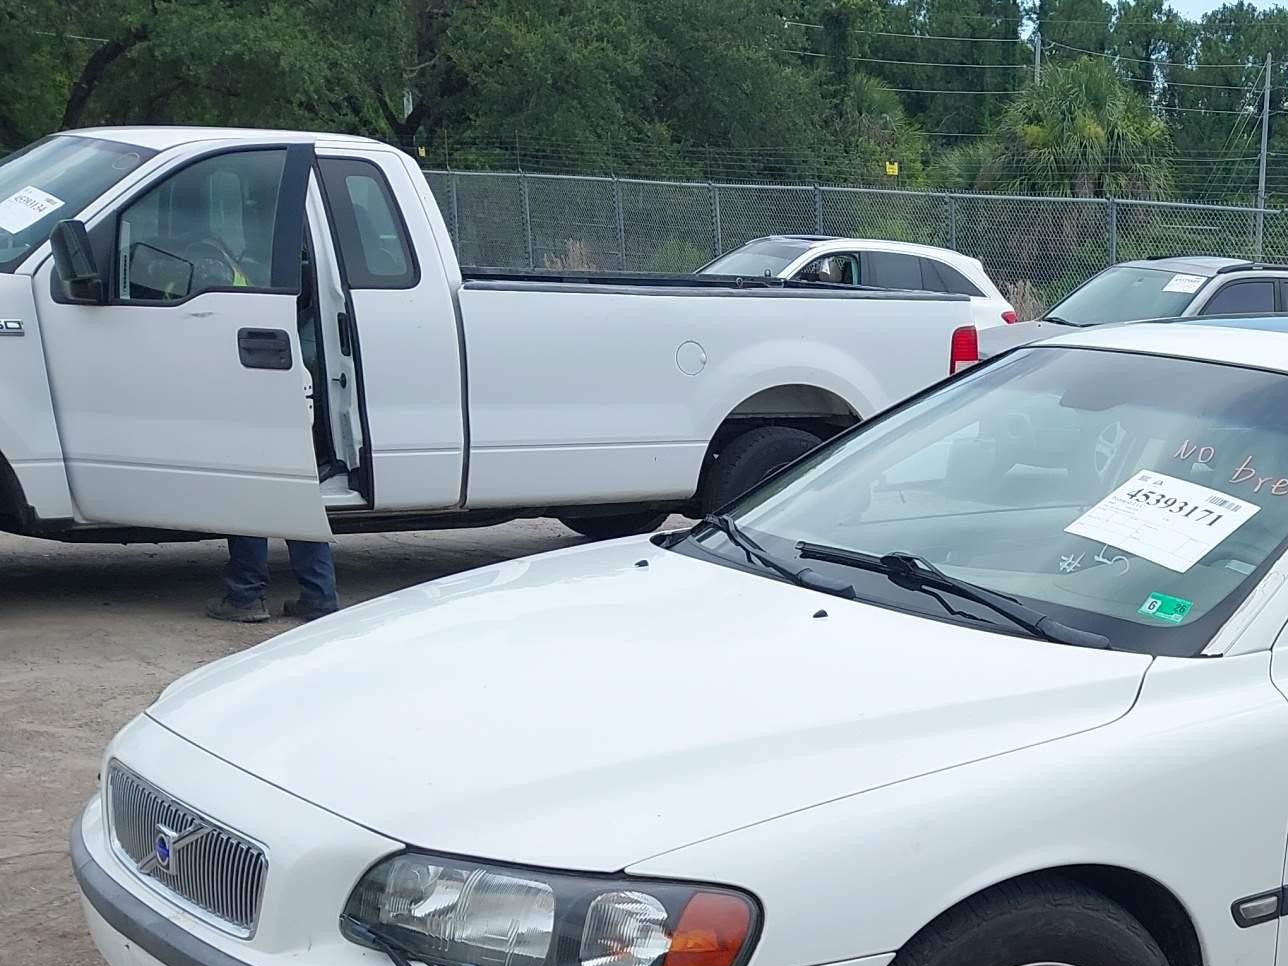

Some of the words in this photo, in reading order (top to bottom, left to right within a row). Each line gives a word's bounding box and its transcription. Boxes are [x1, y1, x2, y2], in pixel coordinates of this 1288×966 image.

[1126, 488, 1224, 527] 45393171
[1147, 600, 1158, 611] 6
[1173, 603, 1187, 614] 26
